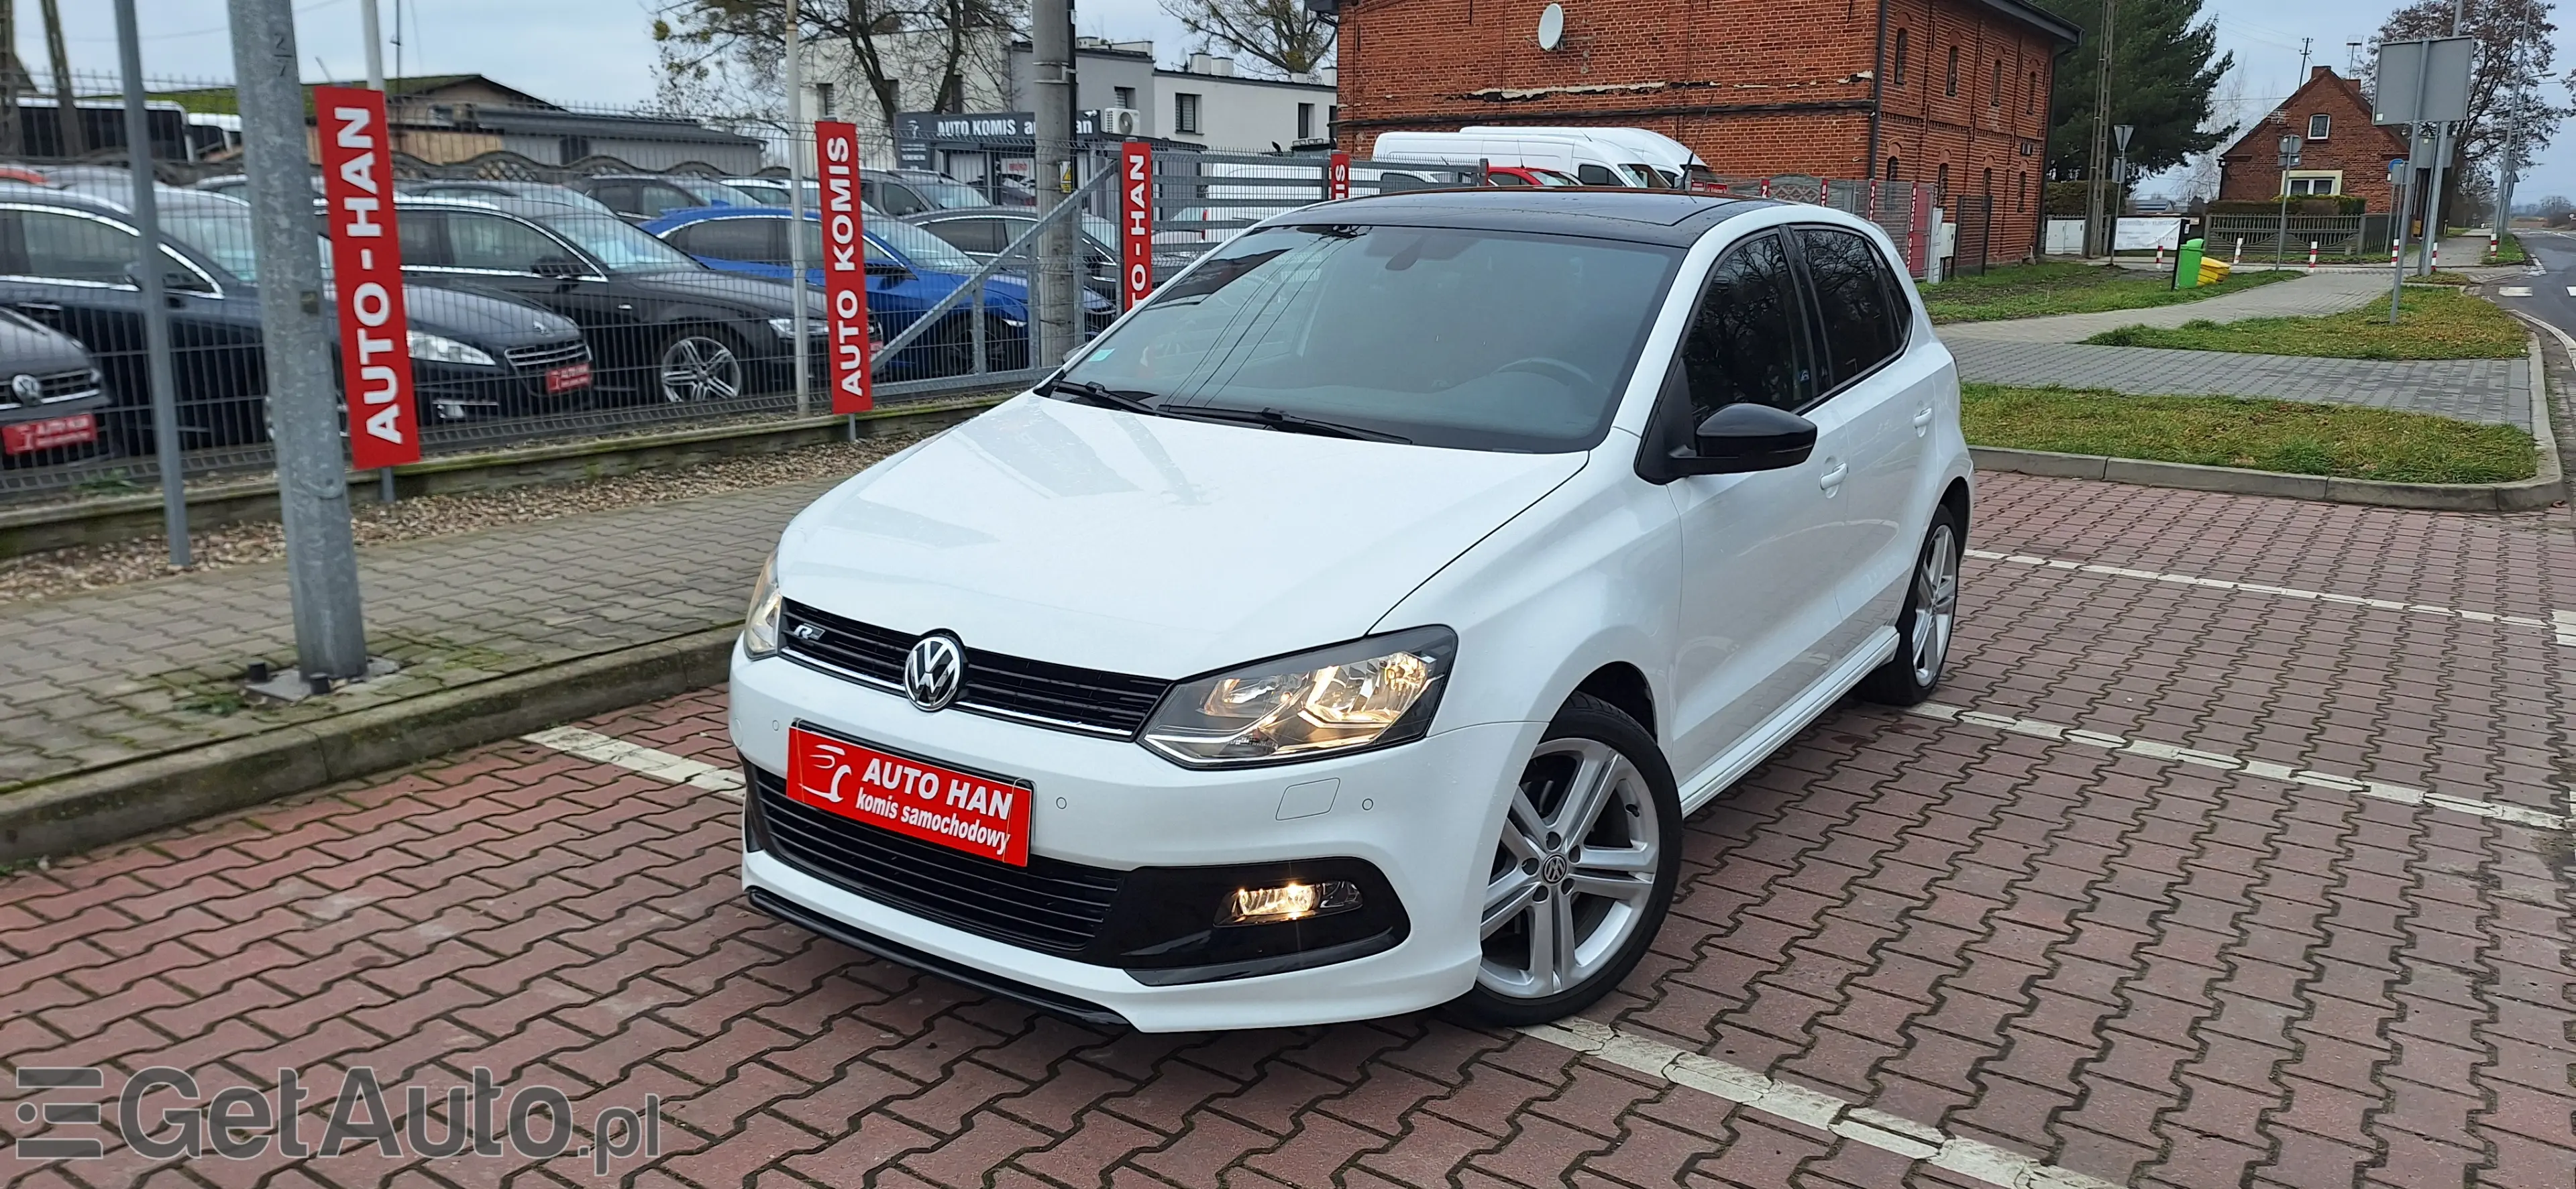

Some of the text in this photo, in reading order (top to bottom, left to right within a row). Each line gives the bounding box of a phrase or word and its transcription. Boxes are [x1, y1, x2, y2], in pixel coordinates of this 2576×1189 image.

[936, 120, 969, 137] AUTO
[972, 119, 1016, 136] KOMIS
[334, 107, 383, 238] HAN
[1128, 154, 1146, 235] HAN
[826, 136, 863, 397] AUTO KOMIS
[354, 283, 403, 445] AUTO
[855, 787, 1011, 856] komis samochodowy
[862, 758, 1013, 820] AUTO HAN
